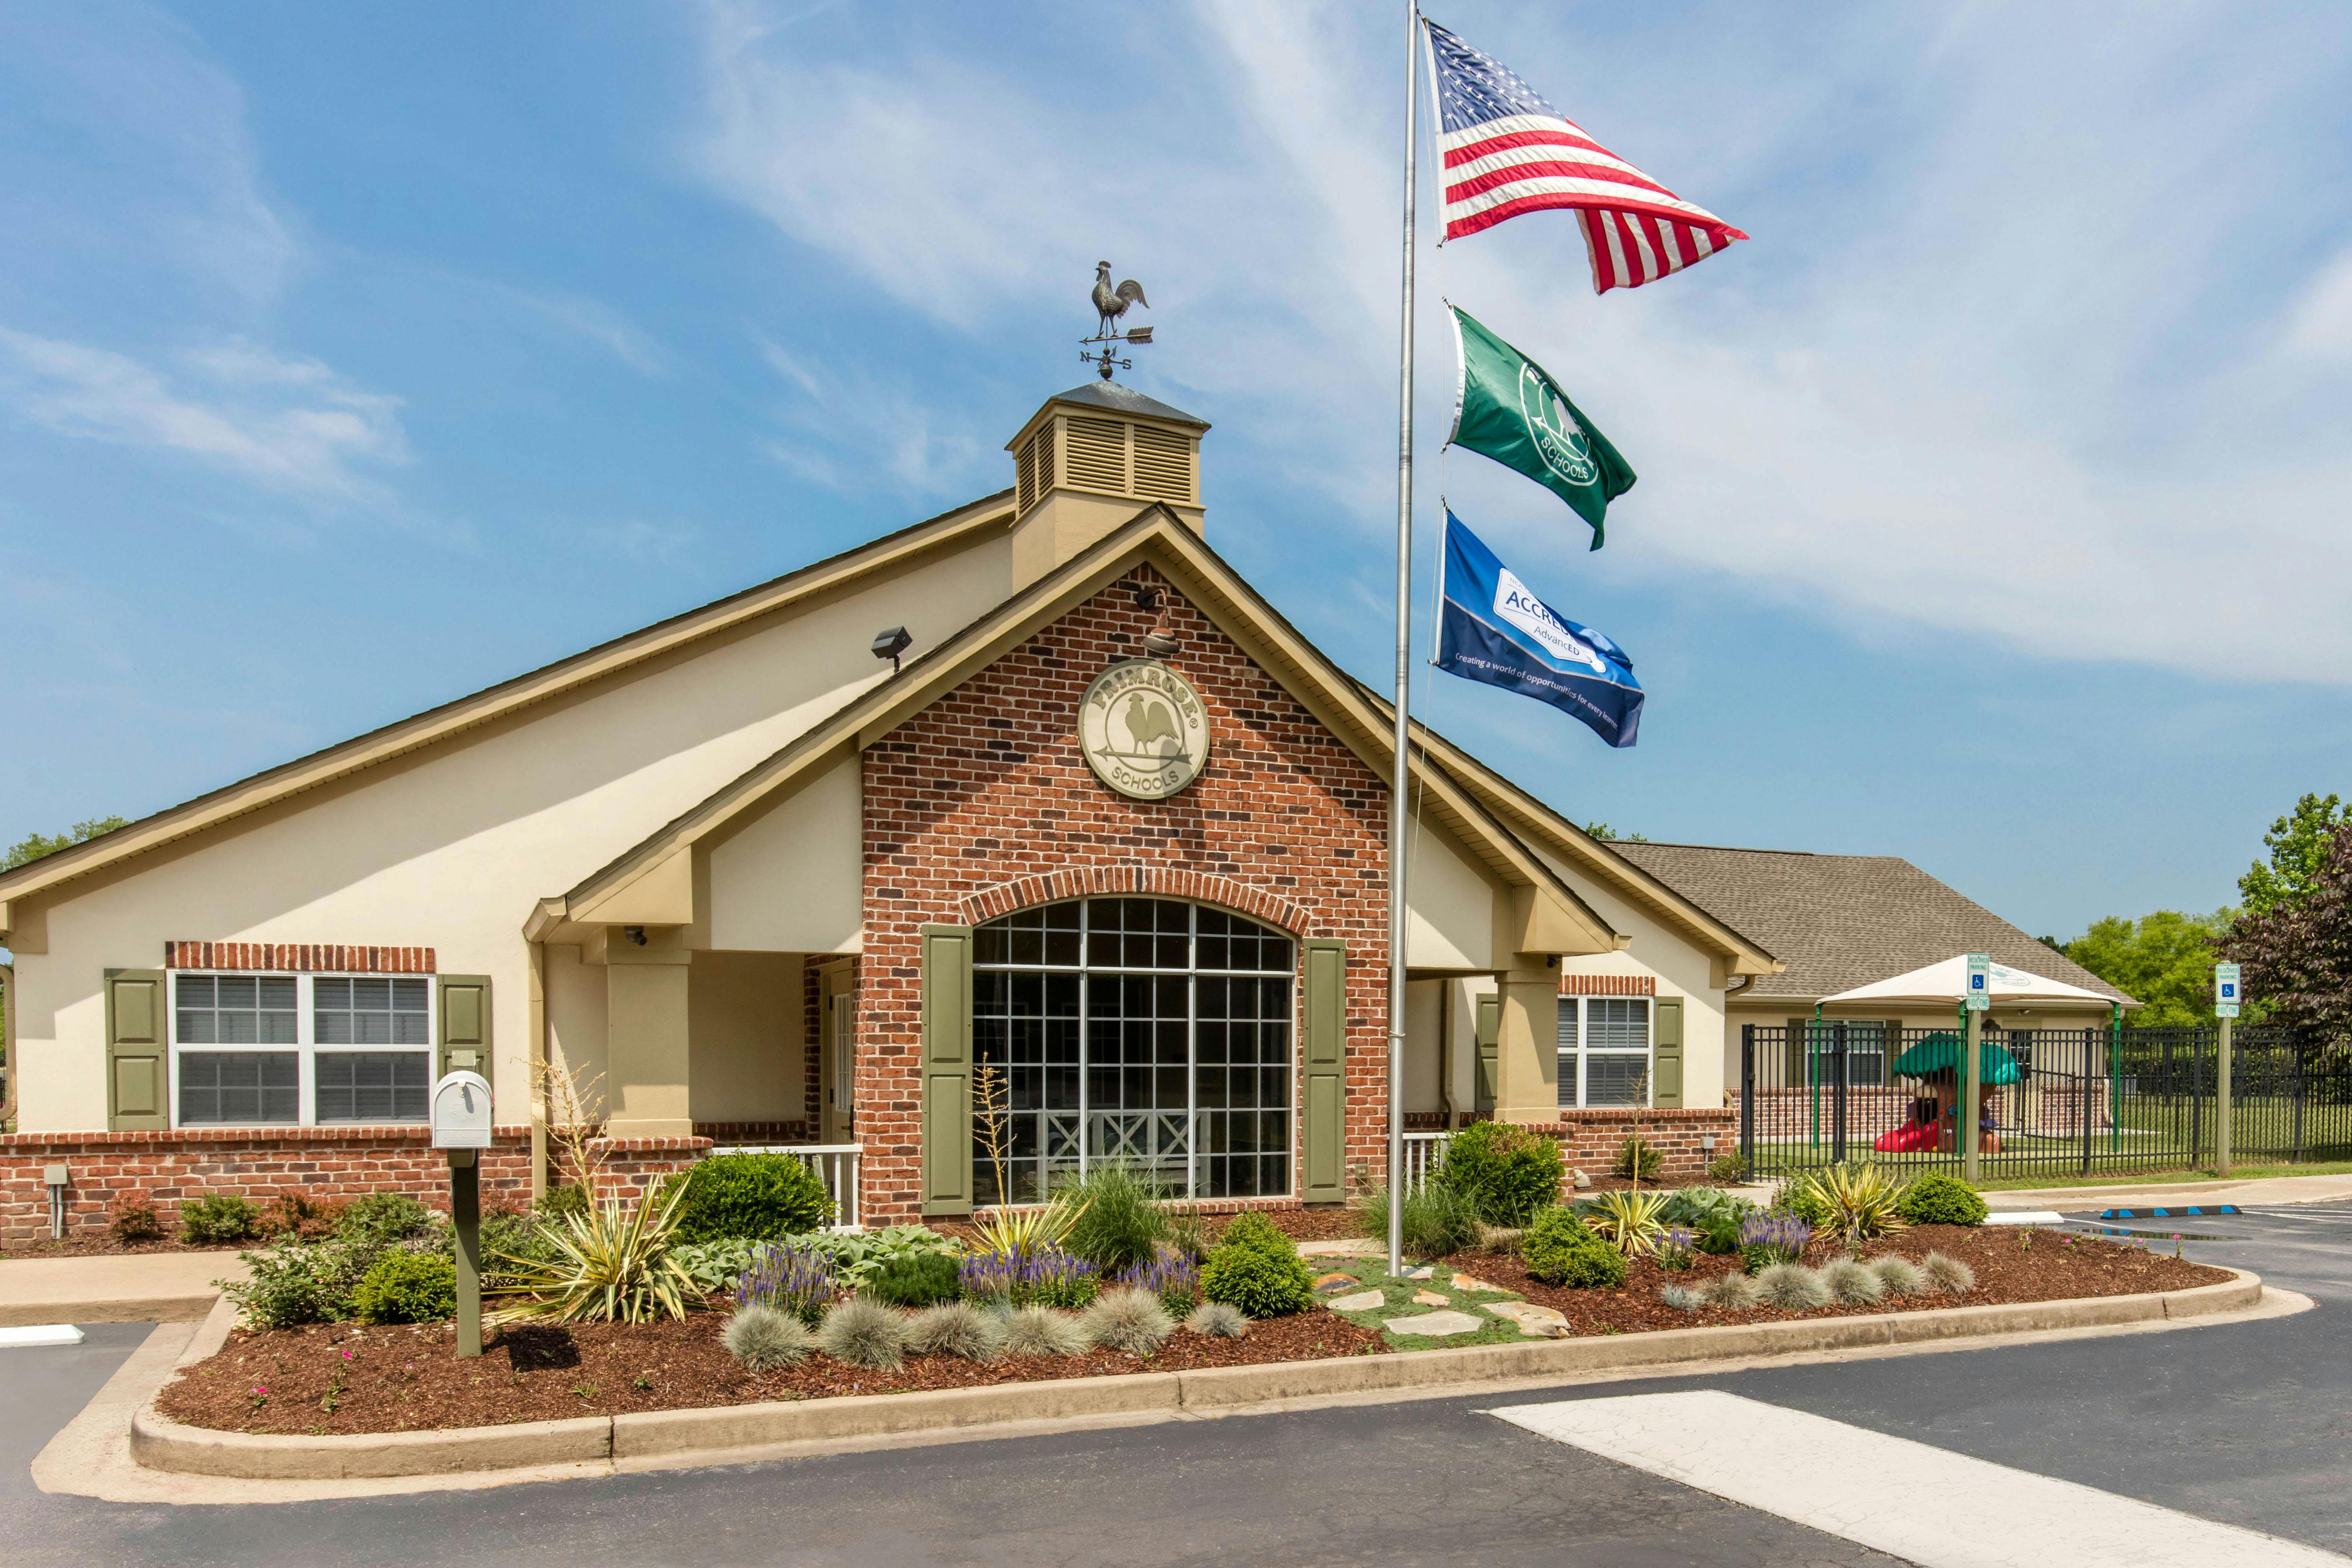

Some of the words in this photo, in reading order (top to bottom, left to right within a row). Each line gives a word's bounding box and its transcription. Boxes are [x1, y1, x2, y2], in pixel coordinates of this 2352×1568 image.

[1122, 358, 1131, 370] S
[1541, 437, 1589, 479] SCHOOLS
[1534, 626, 1579, 656] AdvancED
[1456, 652, 1486, 669] Creating
[1492, 663, 1516, 675] world
[1526, 674, 1577, 699] opportunities
[1577, 694, 1588, 705] for
[1588, 702, 1603, 717] every
[1112, 766, 1179, 791] SCHOOLS
